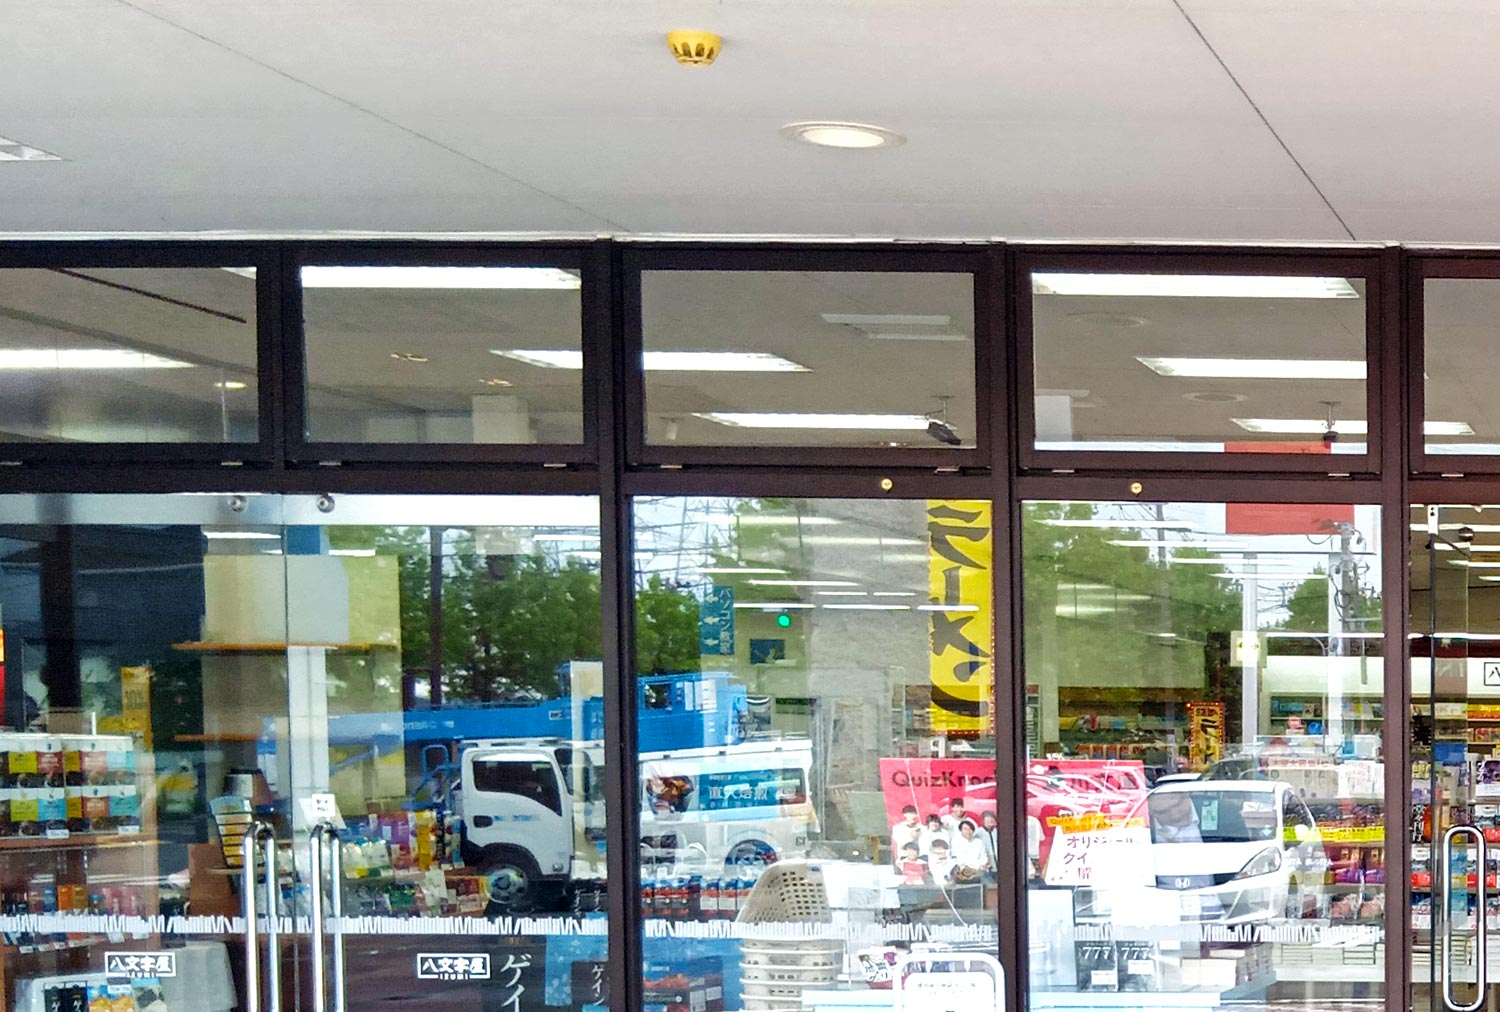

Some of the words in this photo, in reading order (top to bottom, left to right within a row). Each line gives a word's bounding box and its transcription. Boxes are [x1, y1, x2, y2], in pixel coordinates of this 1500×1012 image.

[892, 769, 997, 788] QuizKnoc
[110, 956, 171, 972] 八文字屋
[422, 957, 486, 974] 八文字屋
